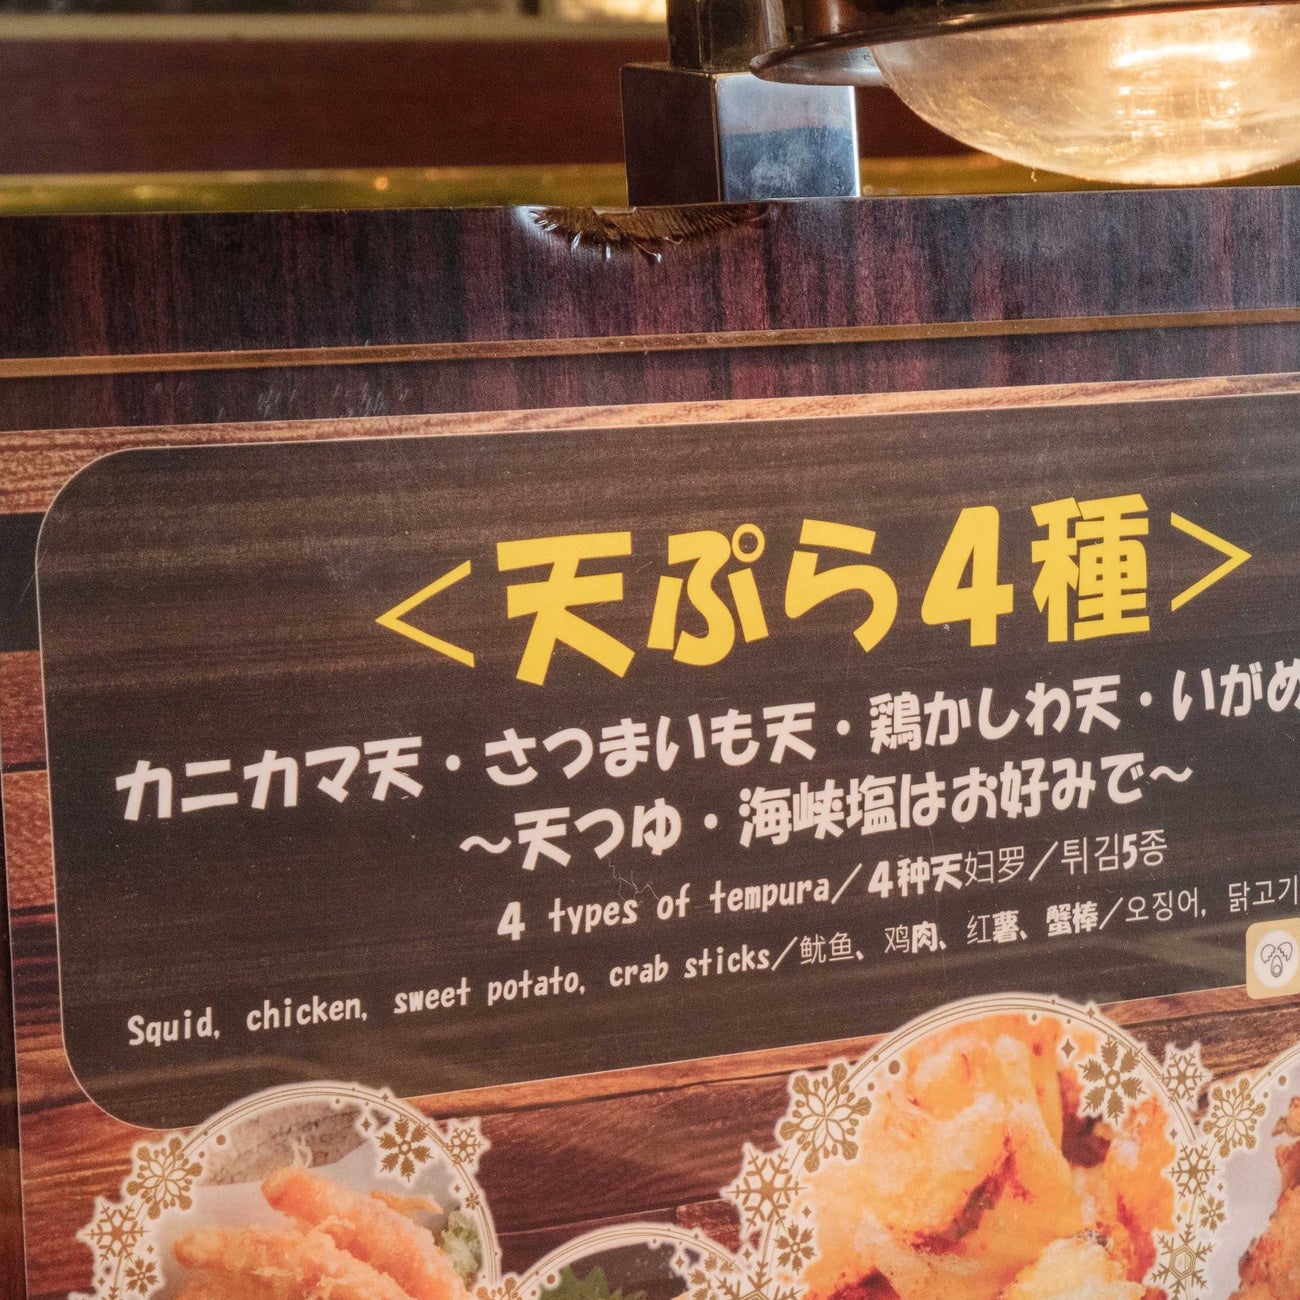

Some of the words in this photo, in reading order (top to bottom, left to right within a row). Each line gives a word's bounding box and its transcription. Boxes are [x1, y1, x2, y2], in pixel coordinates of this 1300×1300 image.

[497, 900, 526, 941] 4
[548, 895, 638, 935] types
[656, 883, 691, 920] of
[127, 1009, 221, 1046] Squid,
[245, 996, 368, 1032] chicken,
[394, 978, 471, 1015] sweet
[487, 966, 586, 1001] potato,
[608, 953, 669, 988] crab
